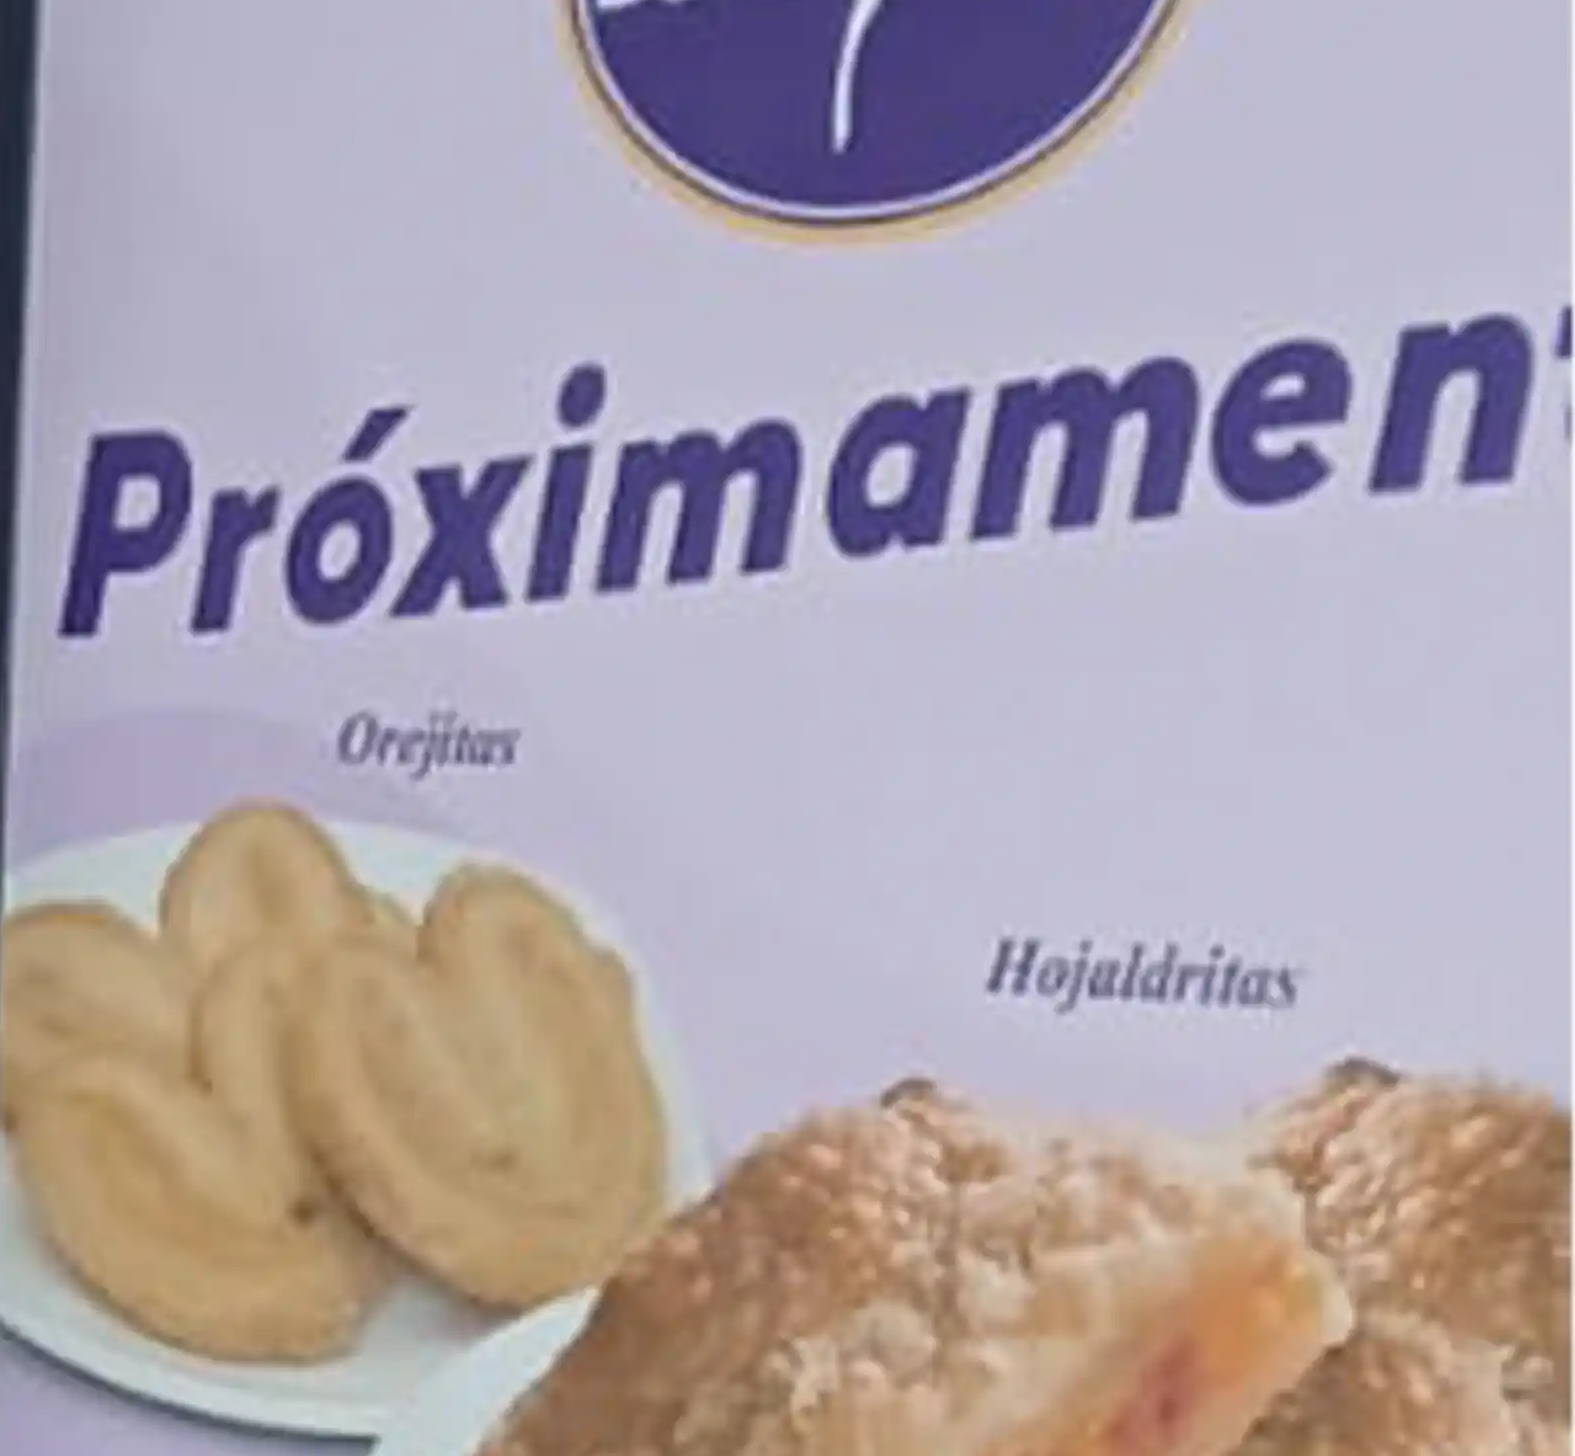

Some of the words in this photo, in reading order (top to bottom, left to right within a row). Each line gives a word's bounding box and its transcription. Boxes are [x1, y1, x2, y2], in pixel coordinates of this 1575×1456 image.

[57, 306, 1571, 637] Próximamen
[336, 708, 521, 782] Orejitas
[985, 938, 1304, 1015] Hojaldritas
